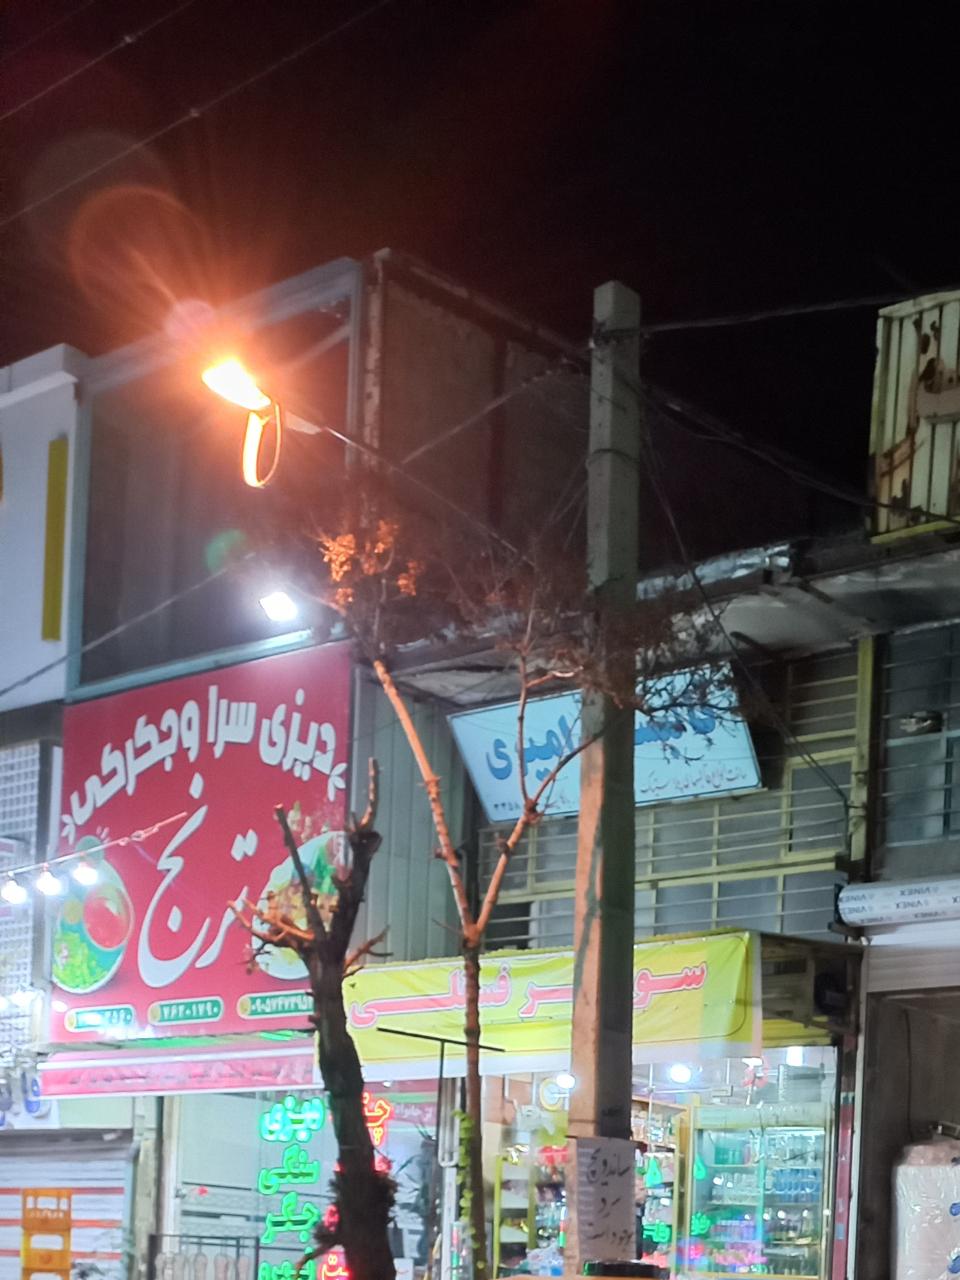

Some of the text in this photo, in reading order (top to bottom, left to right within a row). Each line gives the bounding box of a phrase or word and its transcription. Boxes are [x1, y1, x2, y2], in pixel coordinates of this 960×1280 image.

[206, 685, 257, 758] سرا
[258, 688, 337, 781] دیزی
[137, 772, 259, 988] ترنج
[349, 960, 512, 1029] فسلی
[520, 961, 707, 1017] سور
[258, 1143, 321, 1195] سنگی
[587, 1147, 631, 1186] ساندویچ
[260, 1191, 321, 1244] جگر
